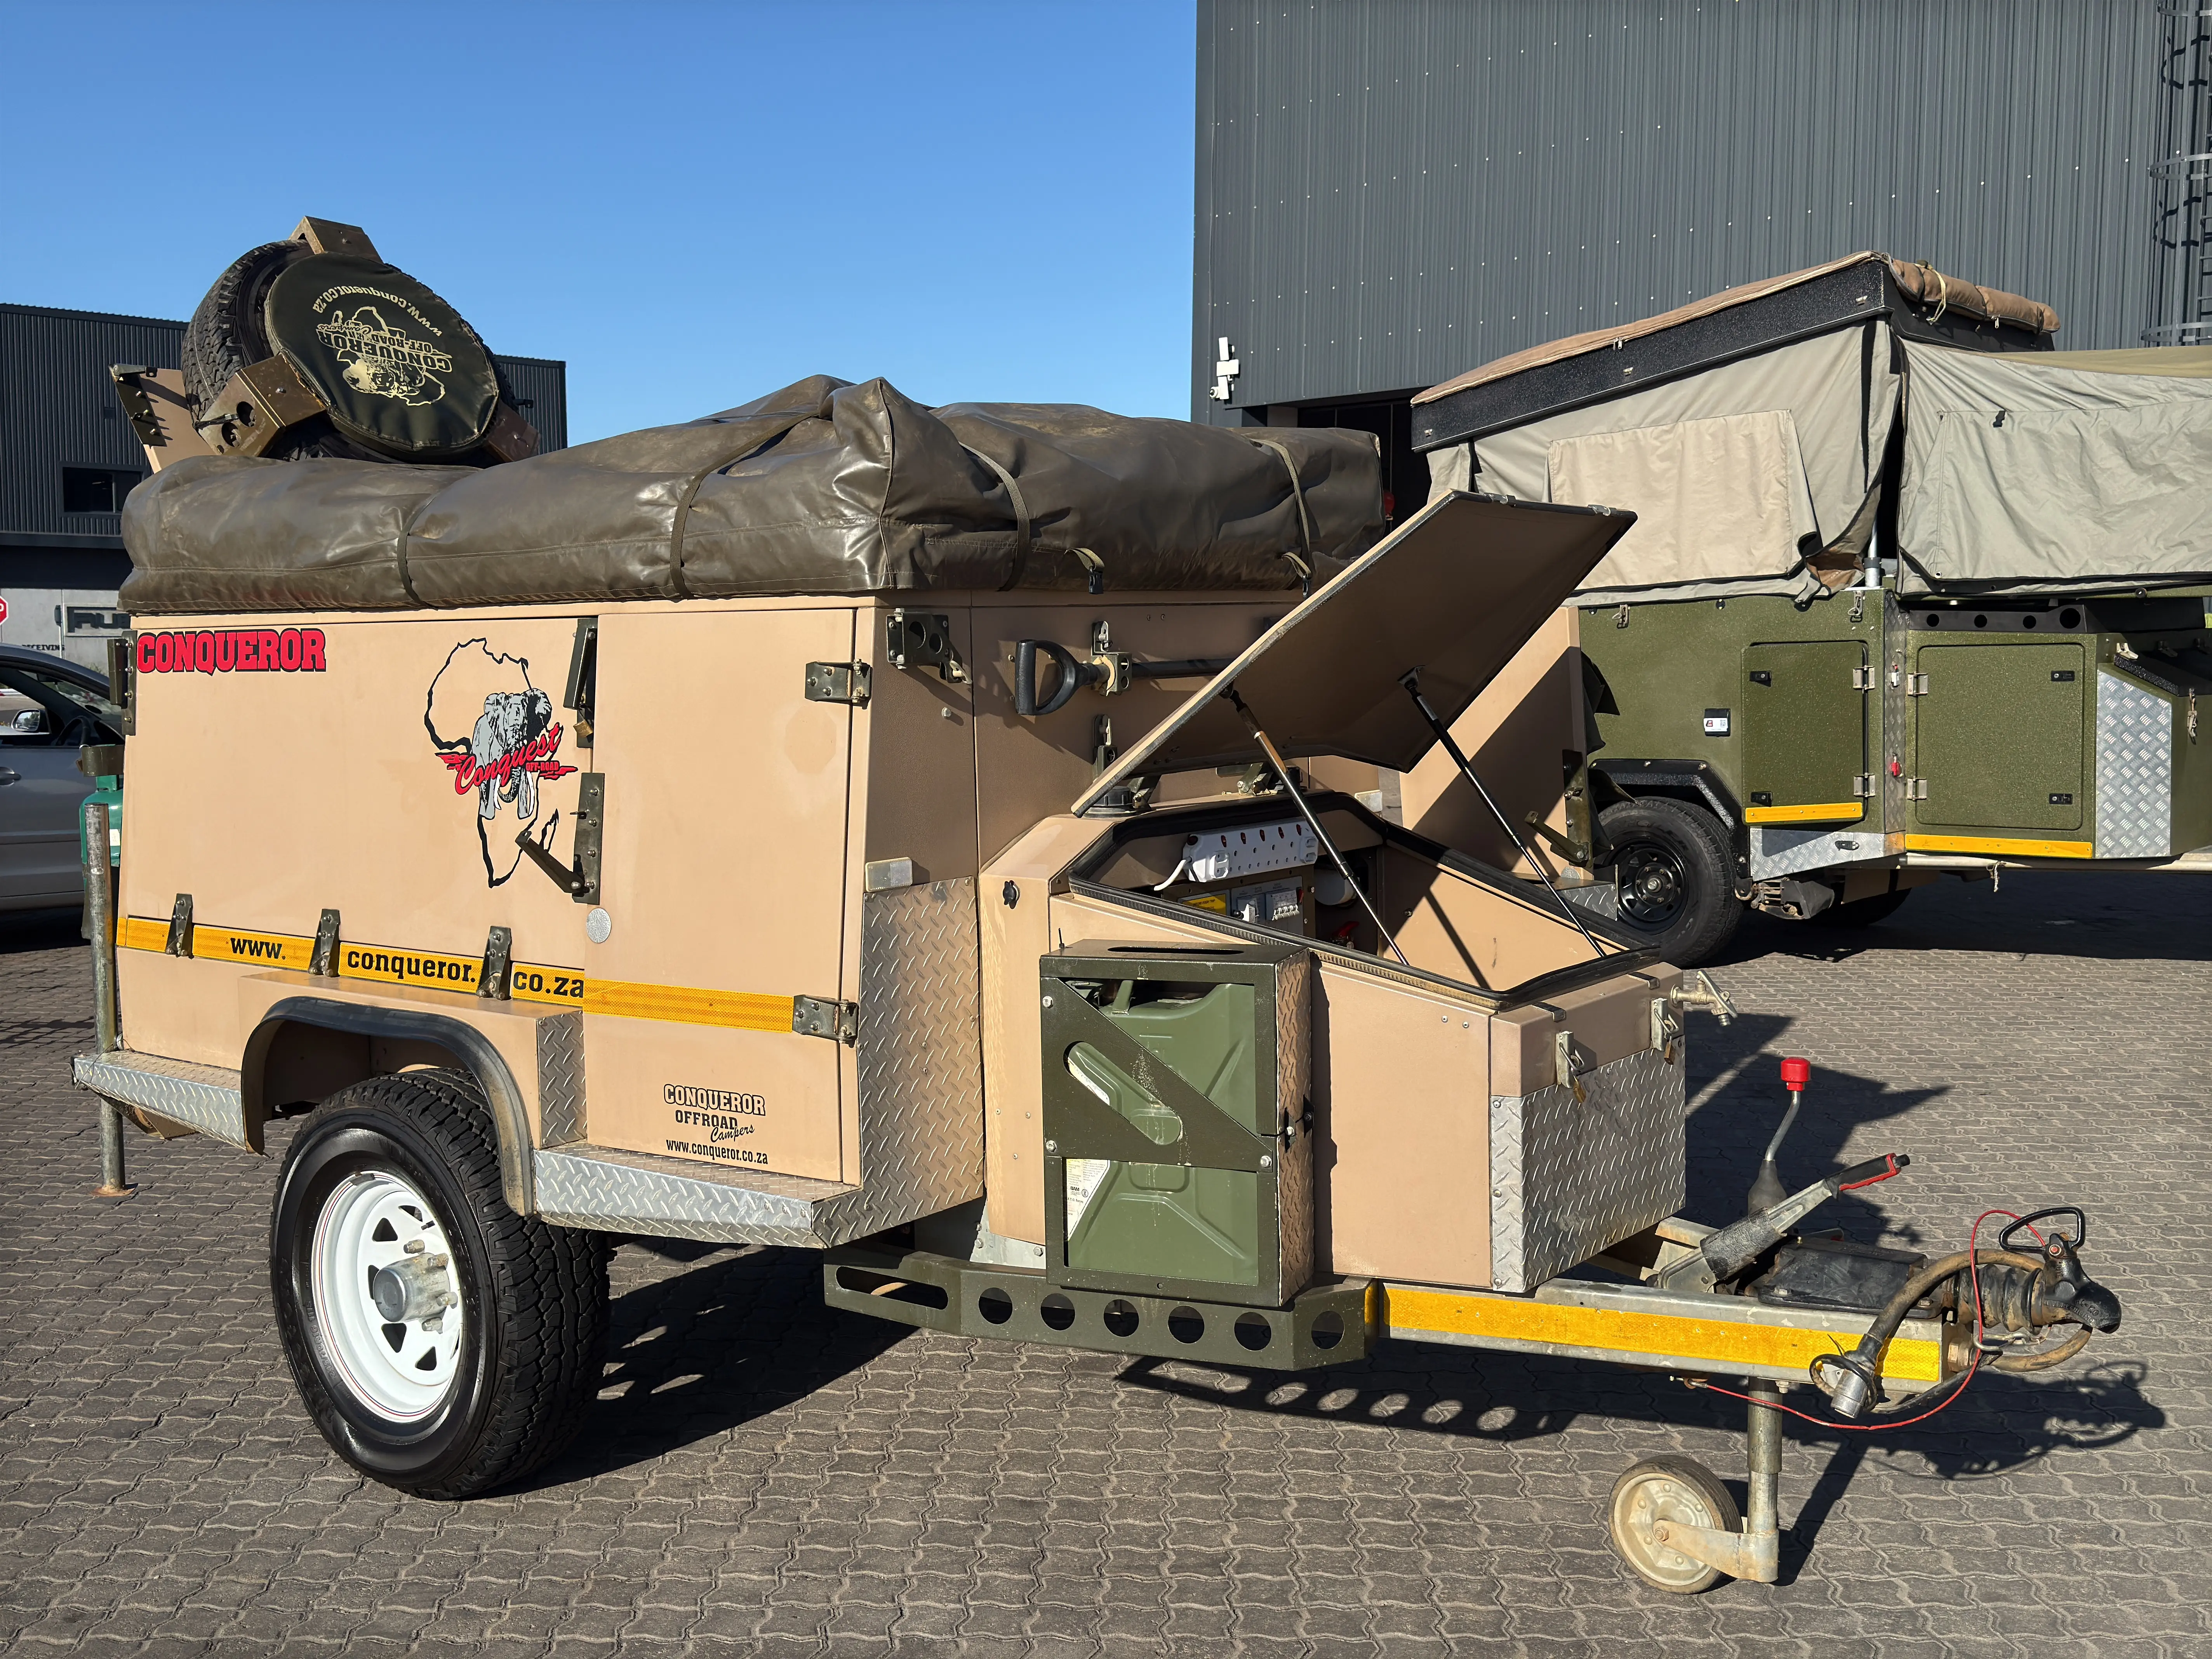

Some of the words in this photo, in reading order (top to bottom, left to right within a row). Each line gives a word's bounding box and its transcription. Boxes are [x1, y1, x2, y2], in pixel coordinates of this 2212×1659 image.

[316, 329, 452, 372] CONQUEROR
[137, 628, 327, 677] CONQUEROR
[455, 722, 560, 795] Conquest
[526, 762, 560, 772] OFF-ROAD
[231, 937, 286, 960] www.
[348, 950, 476, 983] conqueror.
[513, 971, 583, 998] co.za
[664, 1084, 766, 1116] CONQUEROR
[675, 1110, 737, 1130] OFFROAD
[710, 1124, 755, 1143] Campers
[666, 1139, 768, 1165] www.conqueror.co.za
